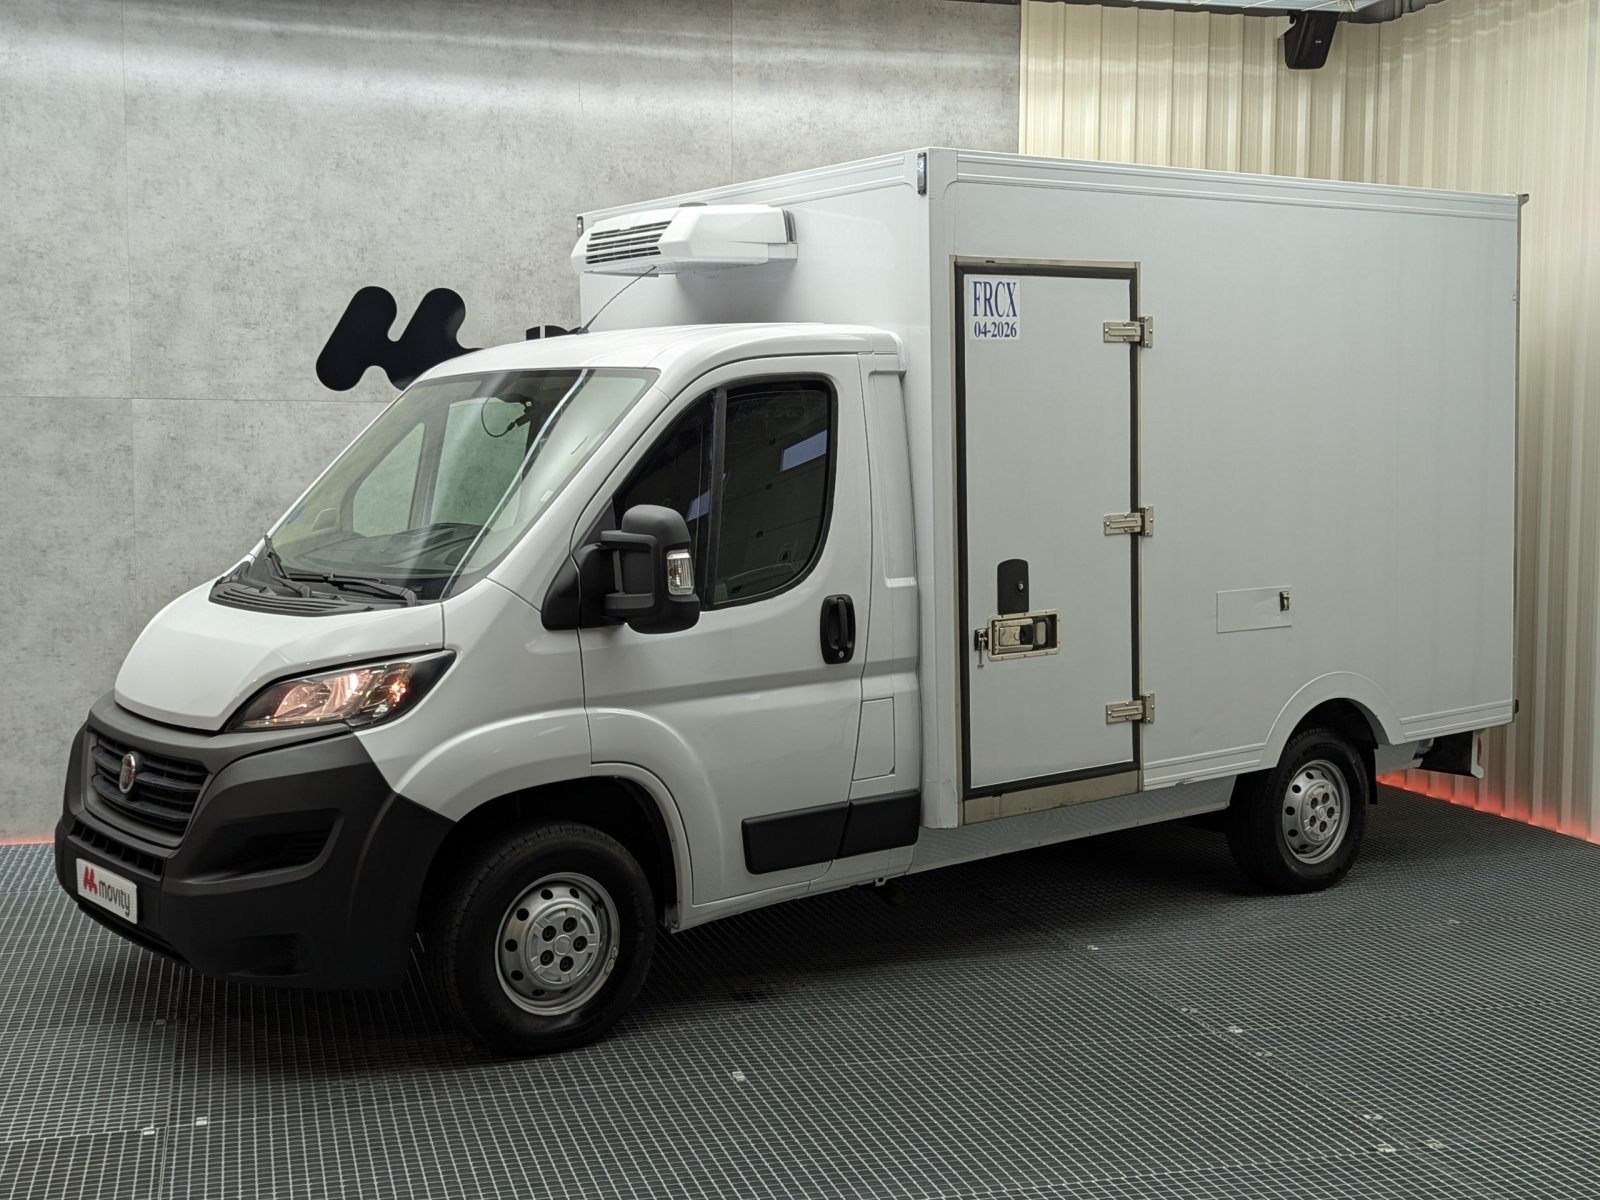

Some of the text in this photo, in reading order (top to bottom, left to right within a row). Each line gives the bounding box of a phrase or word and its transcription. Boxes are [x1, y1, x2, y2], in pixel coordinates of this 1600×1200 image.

[972, 281, 1018, 318] FRCX
[974, 321, 1017, 338] 04-2026
[98, 880, 130, 917] movity
